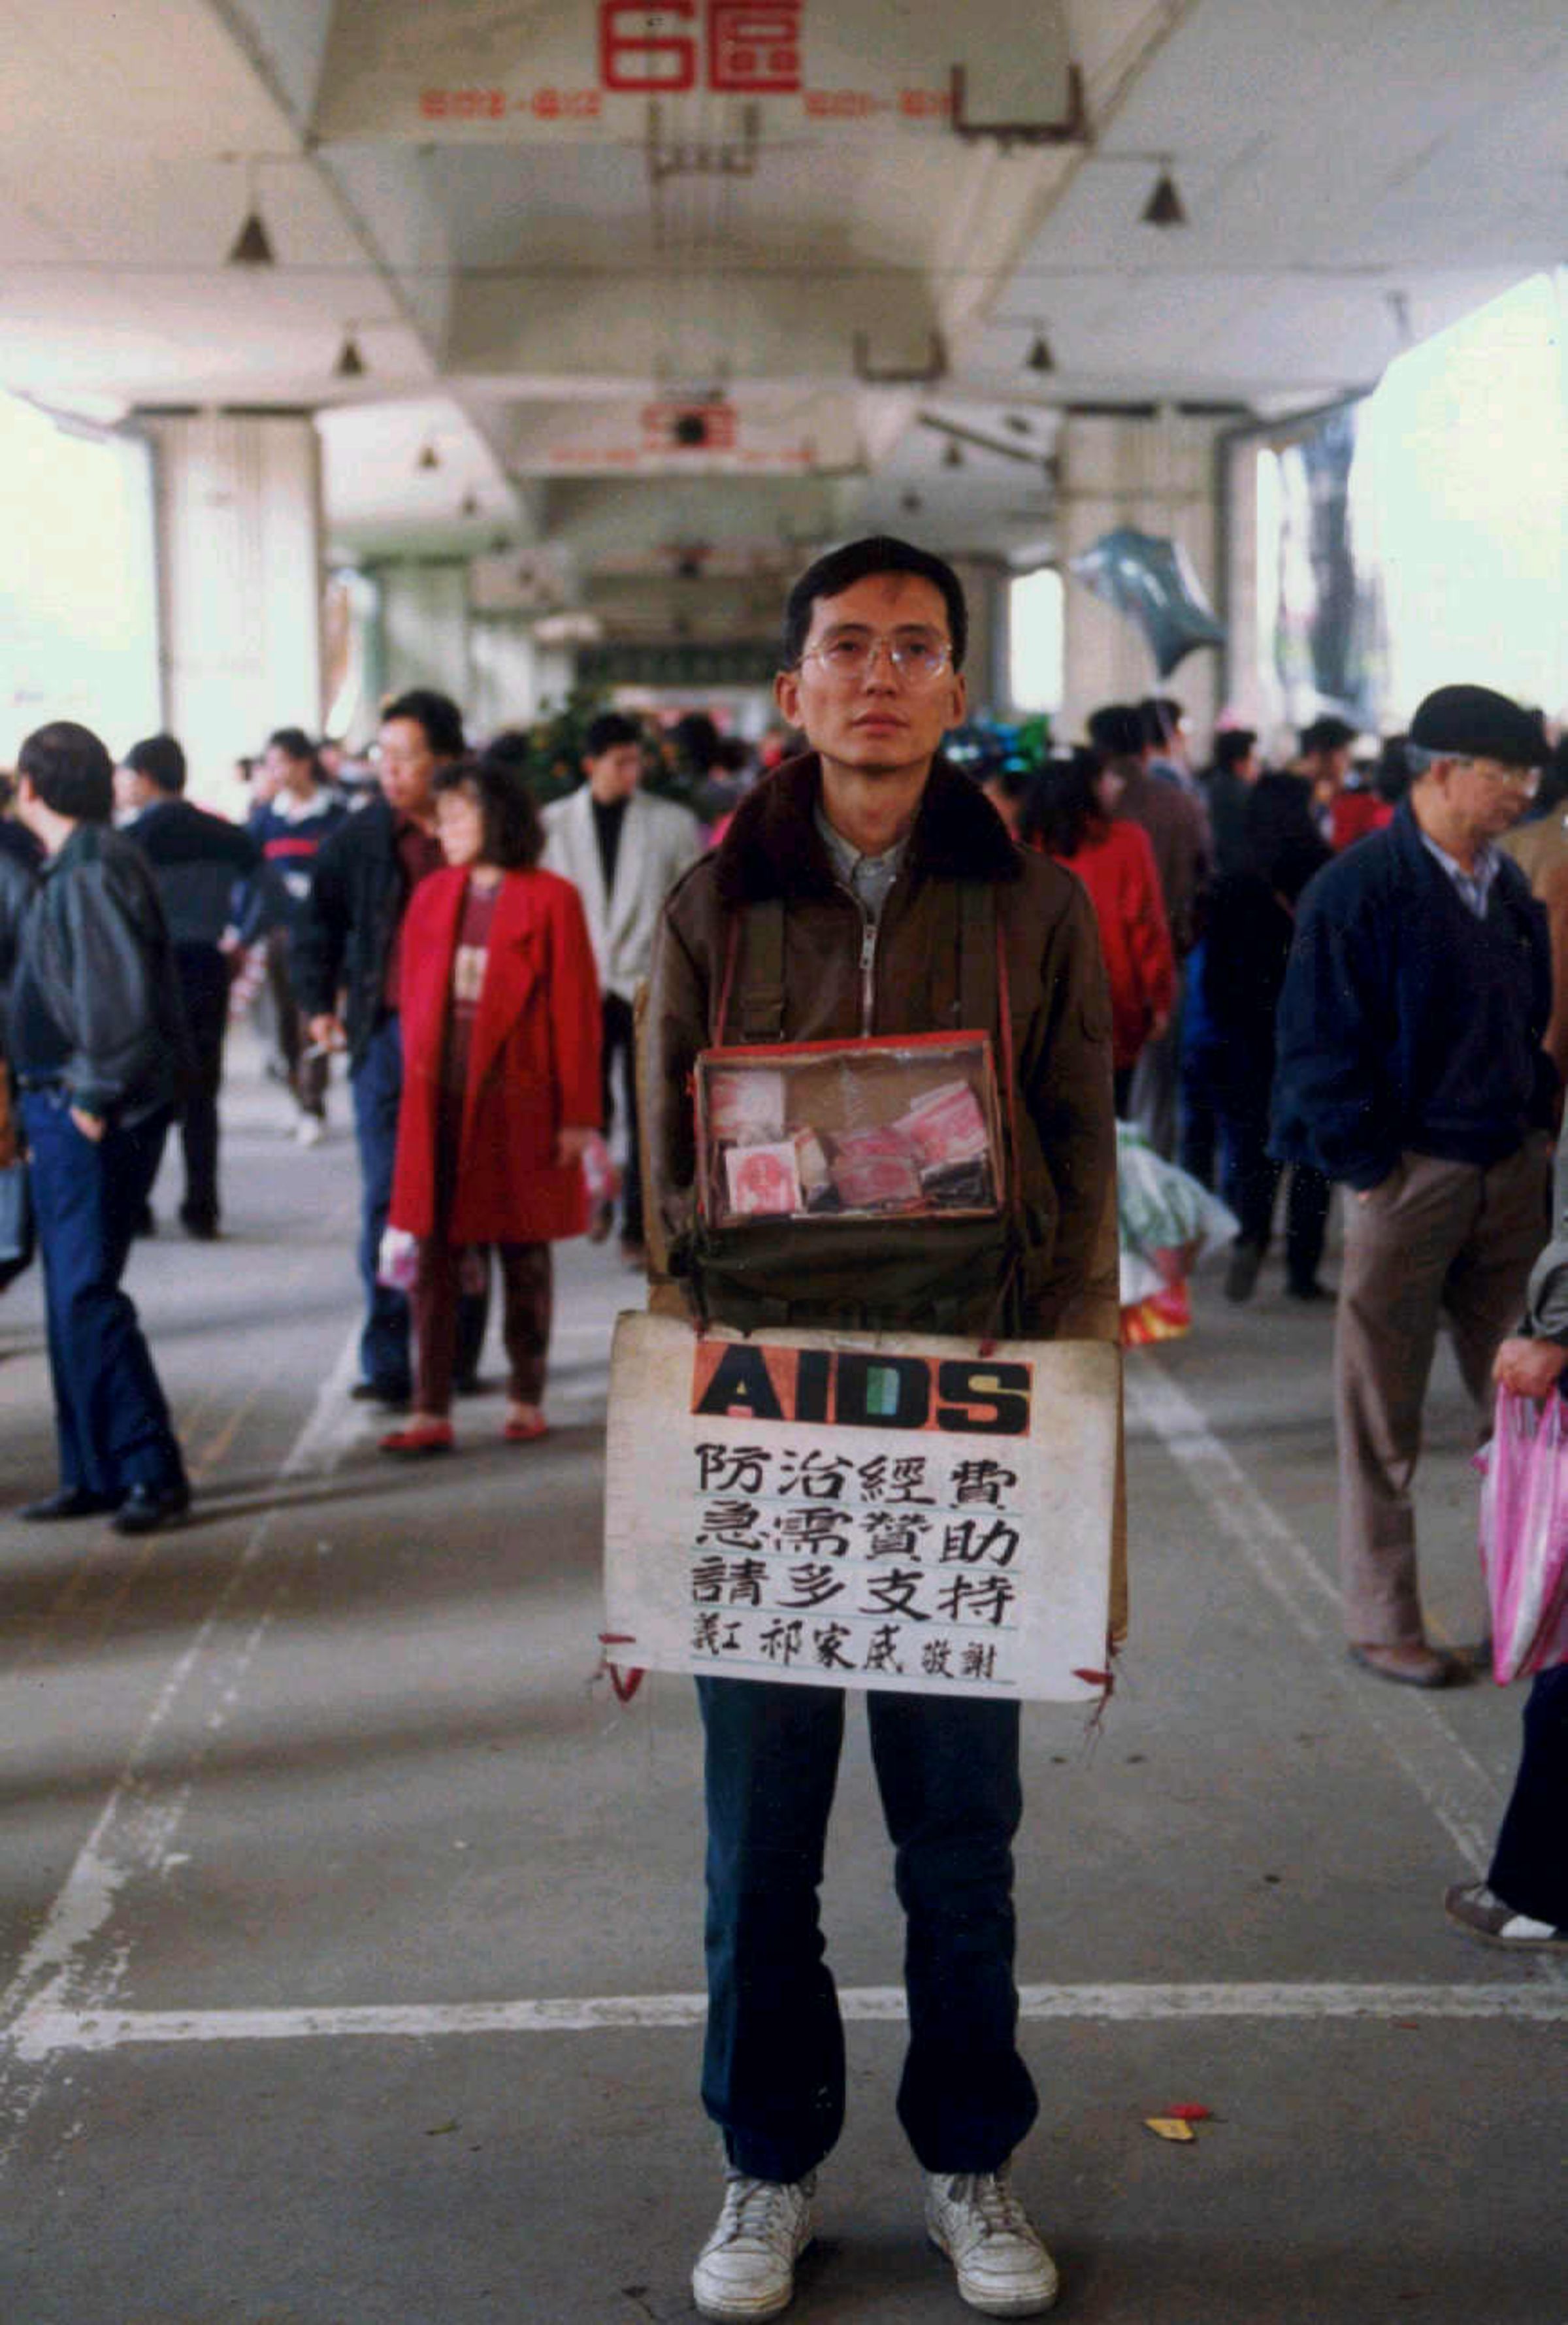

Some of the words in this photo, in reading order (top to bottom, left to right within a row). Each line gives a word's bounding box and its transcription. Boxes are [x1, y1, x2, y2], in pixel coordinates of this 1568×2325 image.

[693, 1344, 1031, 1436] AIDS
[694, 1442, 1017, 1510] 防治經費
[694, 1500, 1021, 1566] 急需贊助
[691, 1557, 1016, 1627] 請多支持
